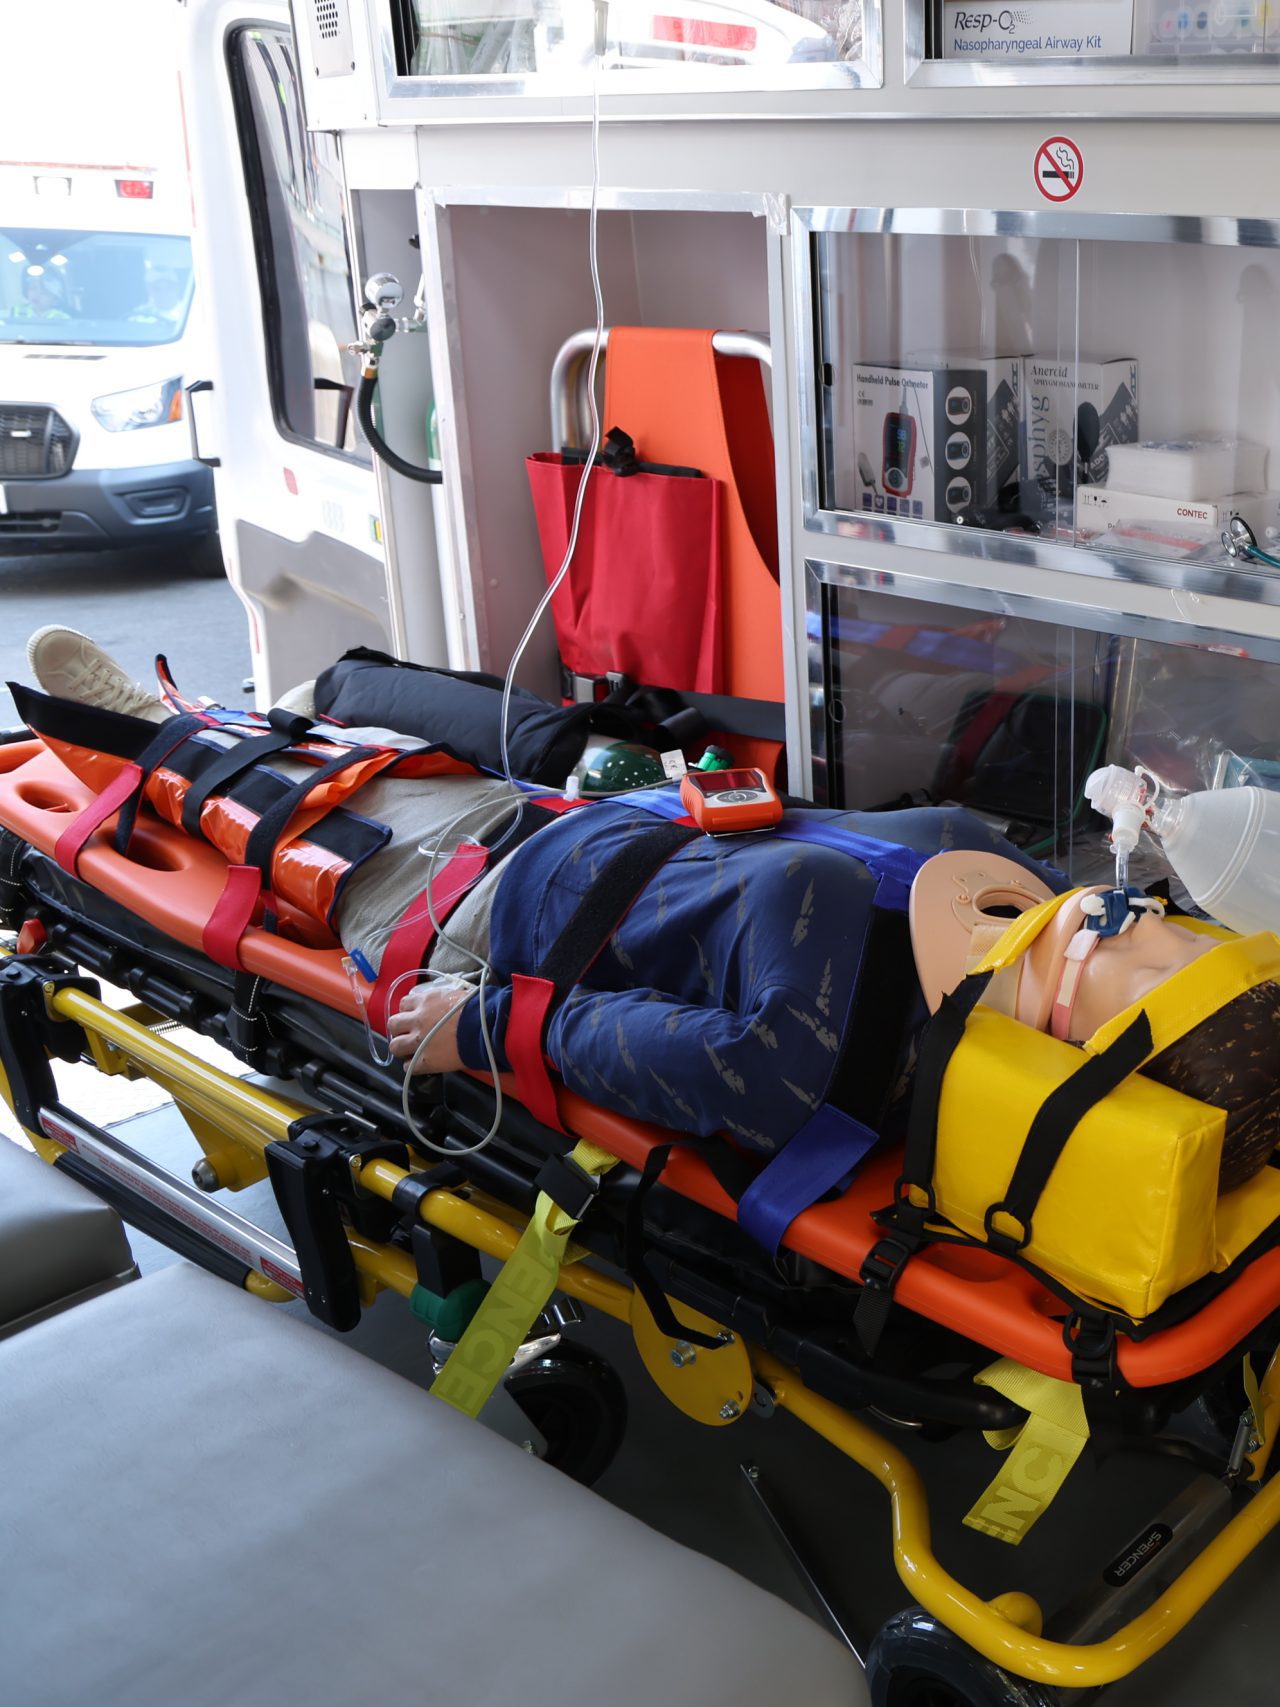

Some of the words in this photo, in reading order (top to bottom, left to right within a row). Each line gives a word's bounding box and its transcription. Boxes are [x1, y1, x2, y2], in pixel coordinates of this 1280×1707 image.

[954, 37, 1042, 53] Nasopharyngeal
[1045, 36, 1083, 51] Airway
[1087, 35, 1102, 48] Kit
[856, 373, 884, 386] Handheld
[885, 376, 900, 386] Pulse
[1176, 507, 1208, 520] CONTEC
[1113, 1531, 1162, 1578] SPENCER
